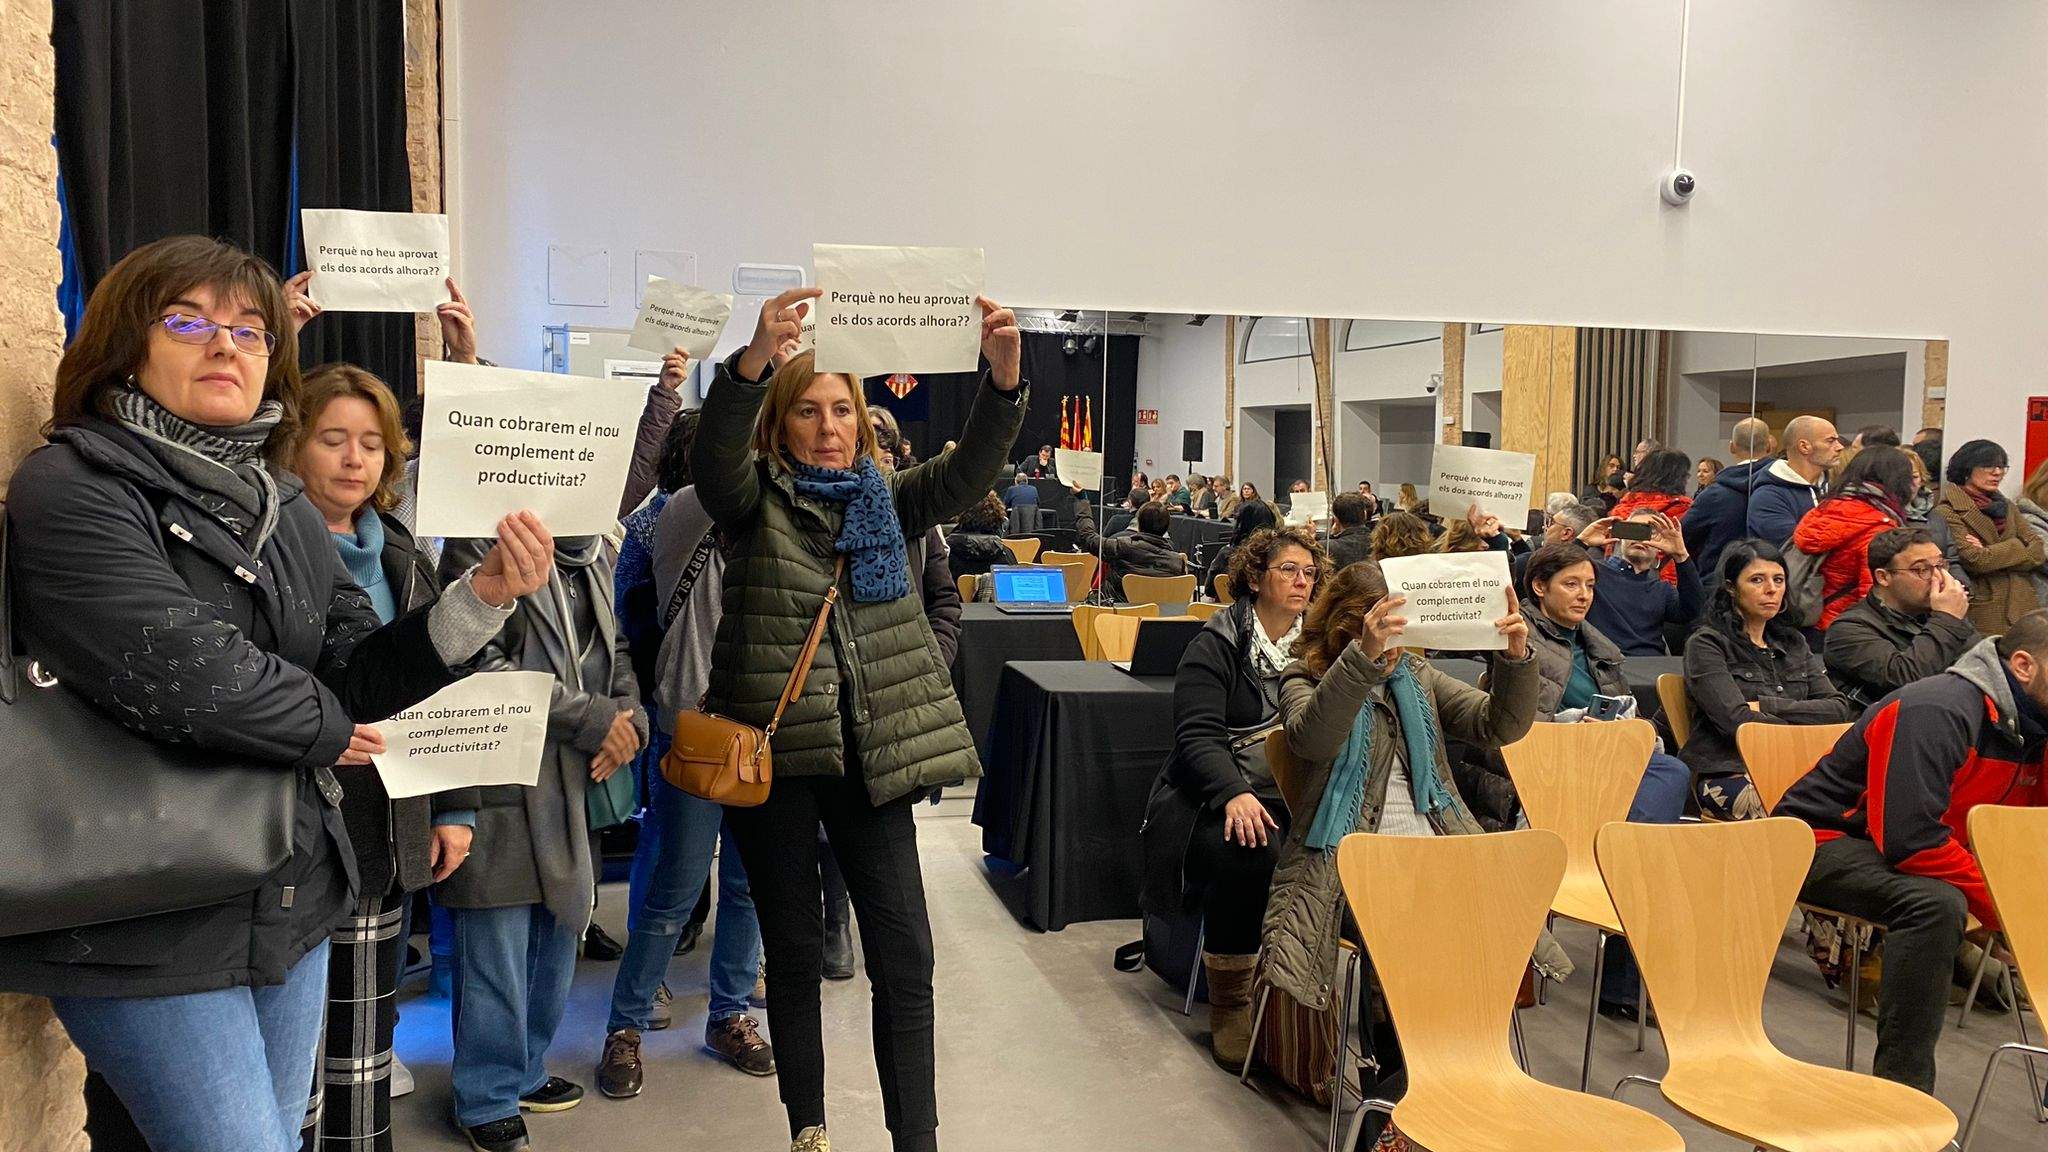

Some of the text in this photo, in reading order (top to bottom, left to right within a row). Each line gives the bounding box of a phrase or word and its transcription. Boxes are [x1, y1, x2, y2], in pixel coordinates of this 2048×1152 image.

[319, 245, 438, 260] Perquè no heu aprovat
[320, 263, 440, 276] els dos acords alhora??
[831, 291, 970, 307] Perquè no heu aprovat
[649, 304, 719, 325] Perquè no heu aprovat
[831, 313, 970, 327] els dos acords alhora??
[644, 316, 655, 324] els
[656, 318, 670, 328] dos
[670, 322, 691, 334] acords
[448, 410, 620, 438] Quan cobrarem el nou
[474, 442, 595, 462] complement de
[477, 469, 587, 487] productivitat?
[1440, 472, 1470, 482] Perquè
[1483, 475, 1497, 484] heu
[1498, 479, 1524, 488] aprovat
[1439, 485, 1523, 501] els dos acords alhora??
[687, 547, 710, 577] 1987
[1401, 578, 1500, 591] Quan cobrarem el nou
[1416, 594, 1486, 607] complement de
[1420, 610, 1482, 623] productivitat?
[428, 707, 490, 720] cobrarem
[494, 704, 505, 715] el
[508, 704, 532, 715] nou
[408, 722, 509, 739] complement de
[408, 740, 501, 757] productivitat?
